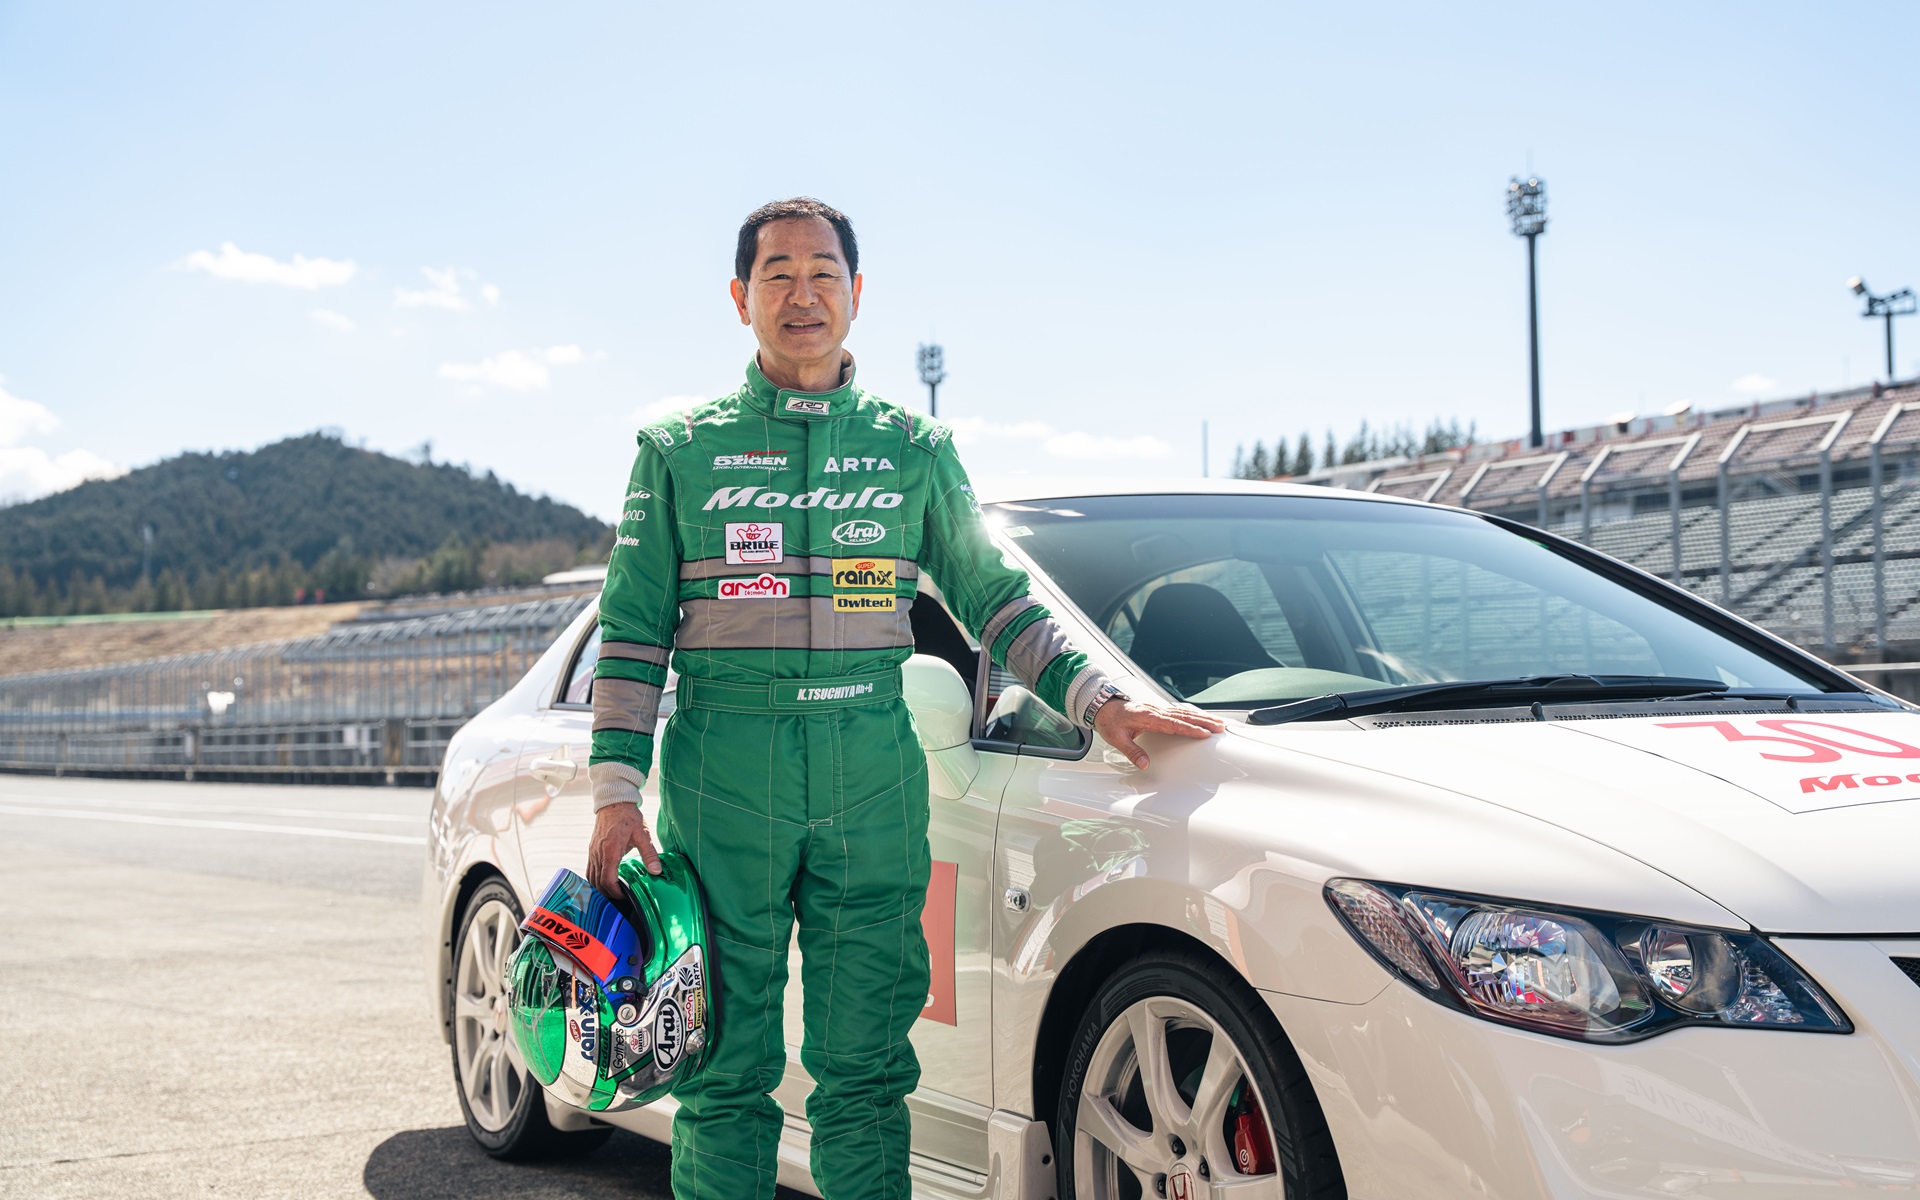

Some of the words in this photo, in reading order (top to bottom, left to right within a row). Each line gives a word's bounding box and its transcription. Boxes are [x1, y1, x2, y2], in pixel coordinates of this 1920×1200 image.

[823, 456, 896, 474] ARTA
[701, 486, 904, 511] Modulo
[838, 523, 881, 539] Arai
[729, 540, 780, 551] BRIDE
[720, 576, 787, 597] amon
[837, 598, 892, 608] Owltech
[1652, 719, 1920, 764] 30
[693, 962, 701, 987] ARTA
[686, 994, 694, 1030] amon
[658, 1006, 676, 1063] Arai
[599, 1026, 610, 1081] Modulo
[613, 1028, 625, 1069] Gathers
[1066, 1022, 1100, 1100] YOKOHAMA
